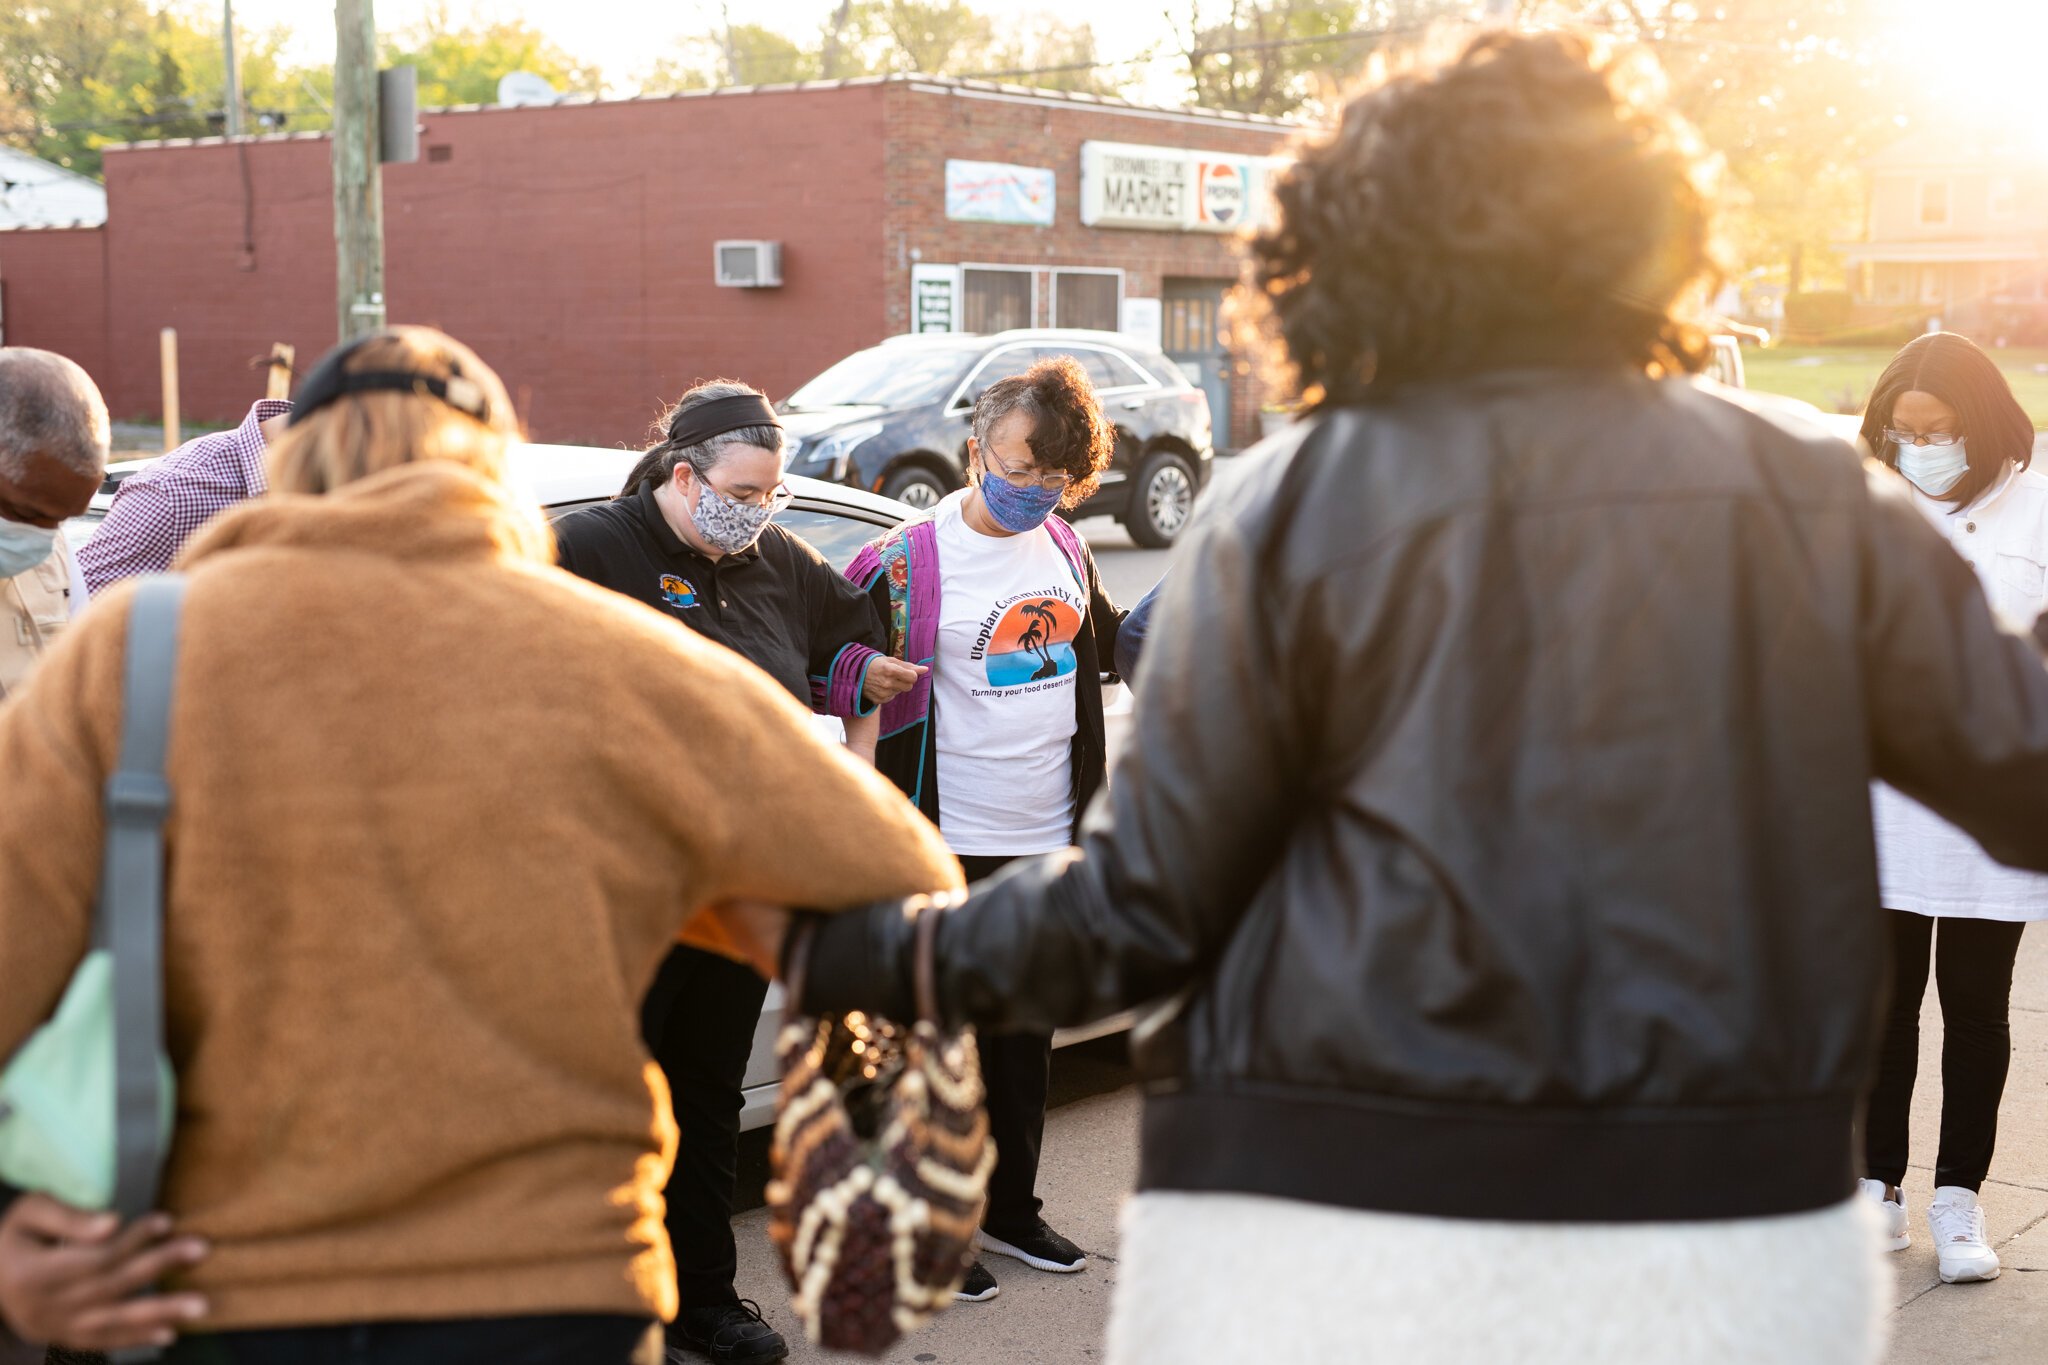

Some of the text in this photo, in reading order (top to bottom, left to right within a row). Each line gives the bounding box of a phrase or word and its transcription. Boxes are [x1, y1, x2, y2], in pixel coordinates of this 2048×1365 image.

[1104, 176, 1185, 216] MARKET
[970, 610, 1000, 660] Utopian
[996, 586, 1071, 609] Community
[971, 689, 1002, 698] Turning
[1004, 688, 1022, 697] your
[1024, 684, 1041, 694] food
[1043, 679, 1063, 690] desert
